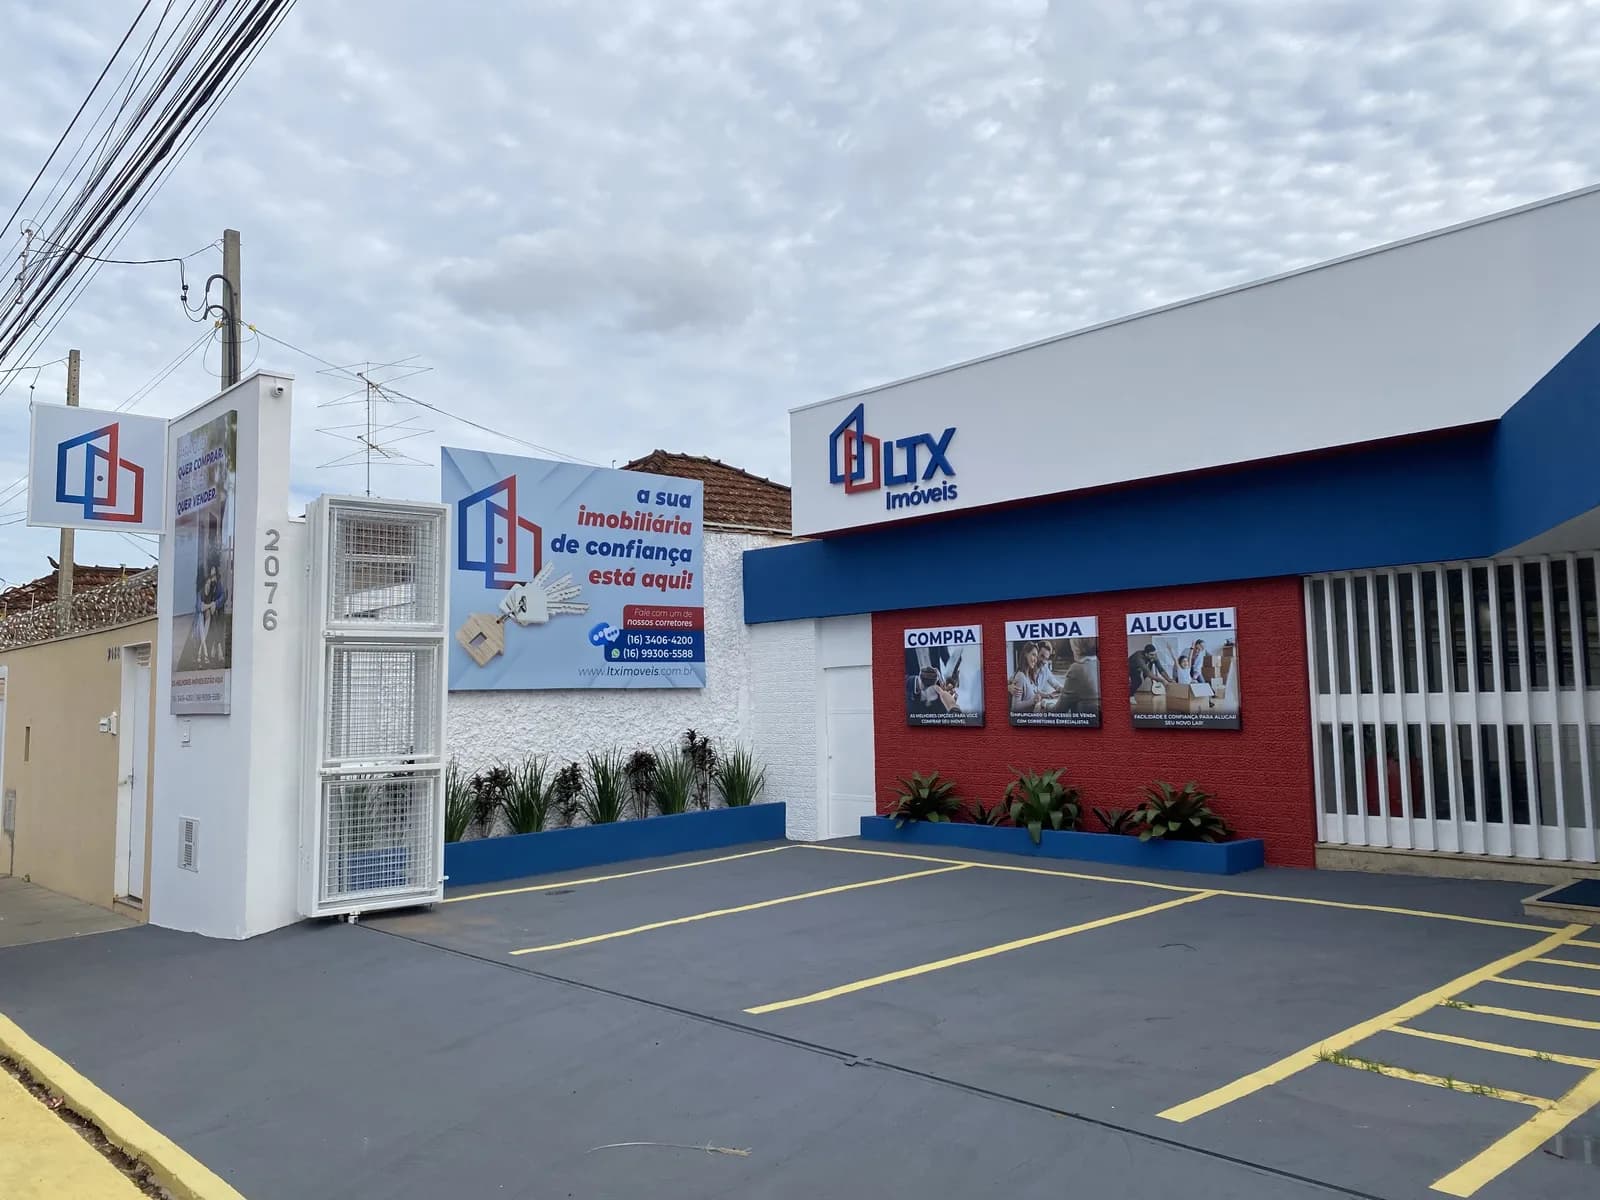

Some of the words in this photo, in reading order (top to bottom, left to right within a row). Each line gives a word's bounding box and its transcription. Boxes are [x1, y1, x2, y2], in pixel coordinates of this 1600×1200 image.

[884, 427, 957, 486] LTX
[178, 462, 193, 480] QUER
[636, 489, 650, 504] a
[655, 491, 692, 509] sua
[886, 480, 958, 510] Imóveis
[177, 498, 192, 516] QUER
[577, 504, 693, 536] imobiliária
[550, 533, 580, 553] de
[585, 536, 693, 567] confiança
[263, 528, 280, 631] 2076
[588, 567, 635, 586] está
[641, 569, 694, 592] aqui!
[634, 607, 651, 617] Fale
[682, 609, 693, 618] de
[1130, 611, 1233, 633] ALUGUEL
[627, 619, 654, 627] nossos
[655, 620, 693, 628] corretores
[1016, 621, 1083, 640] VENDA
[627, 634, 643, 646] (16)
[645, 635, 694, 645] 3406-4200
[907, 629, 977, 647] COMPRA
[623, 648, 639, 659] (16)
[641, 649, 694, 658] 99306-5588
[578, 665, 698, 677] www.ltximoveis.com.br
